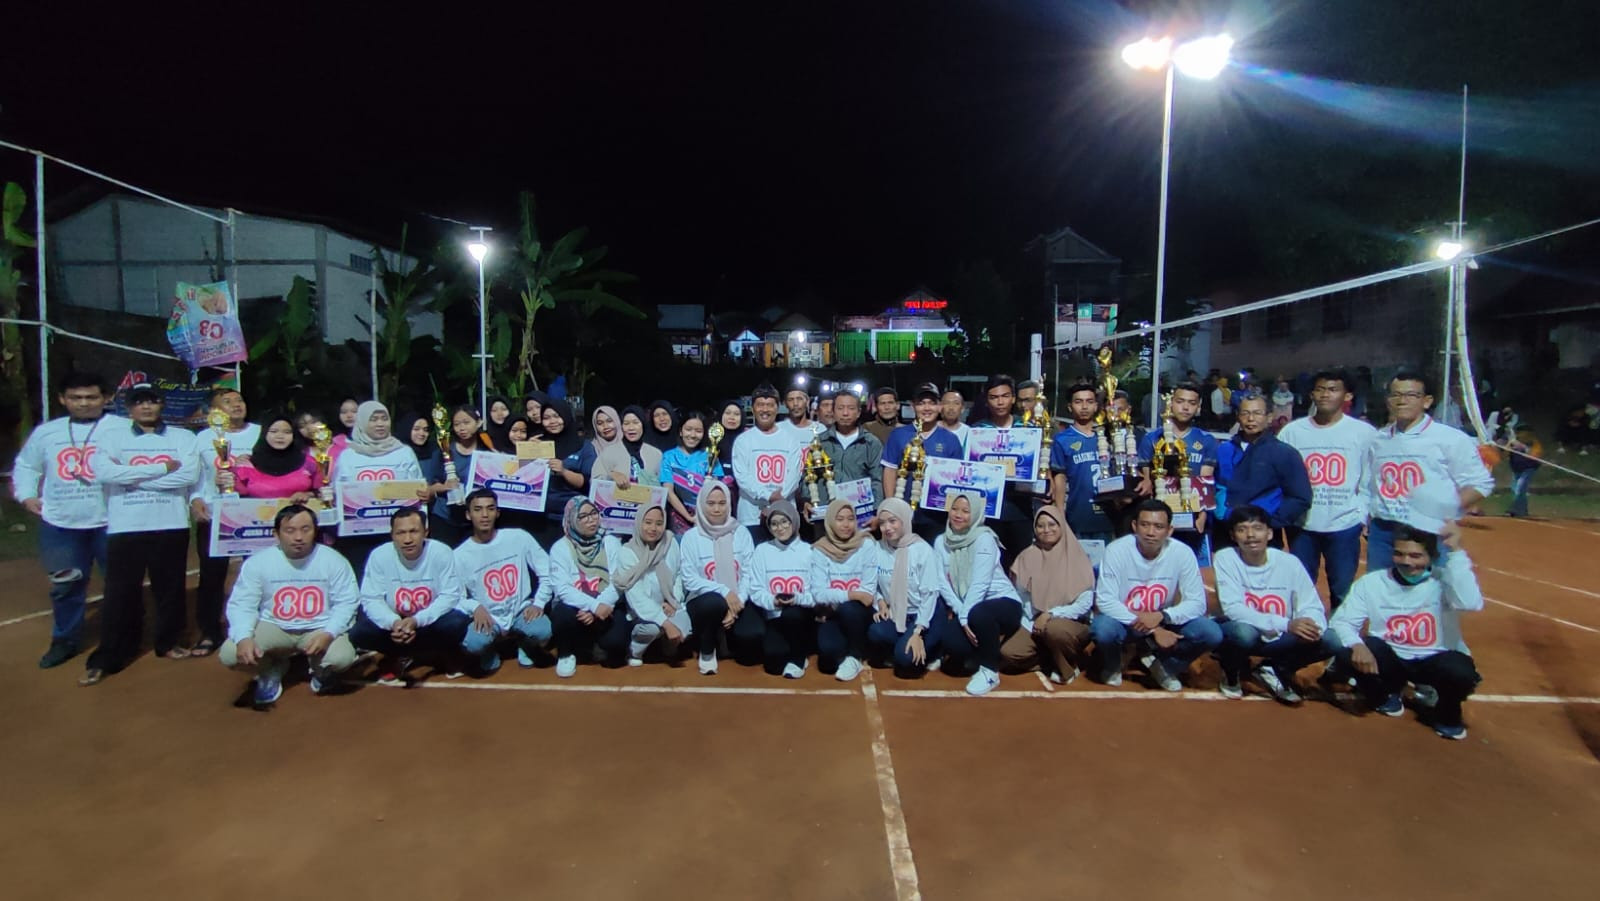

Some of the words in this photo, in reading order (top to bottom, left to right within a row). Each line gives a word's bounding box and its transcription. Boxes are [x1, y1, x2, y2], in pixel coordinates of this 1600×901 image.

[687, 474, 695, 487] 3
[757, 455, 786, 483] 80
[1305, 453, 1346, 486] 80
[484, 564, 518, 601] 80
[272, 585, 324, 620] 80
[1385, 612, 1437, 647] 80
